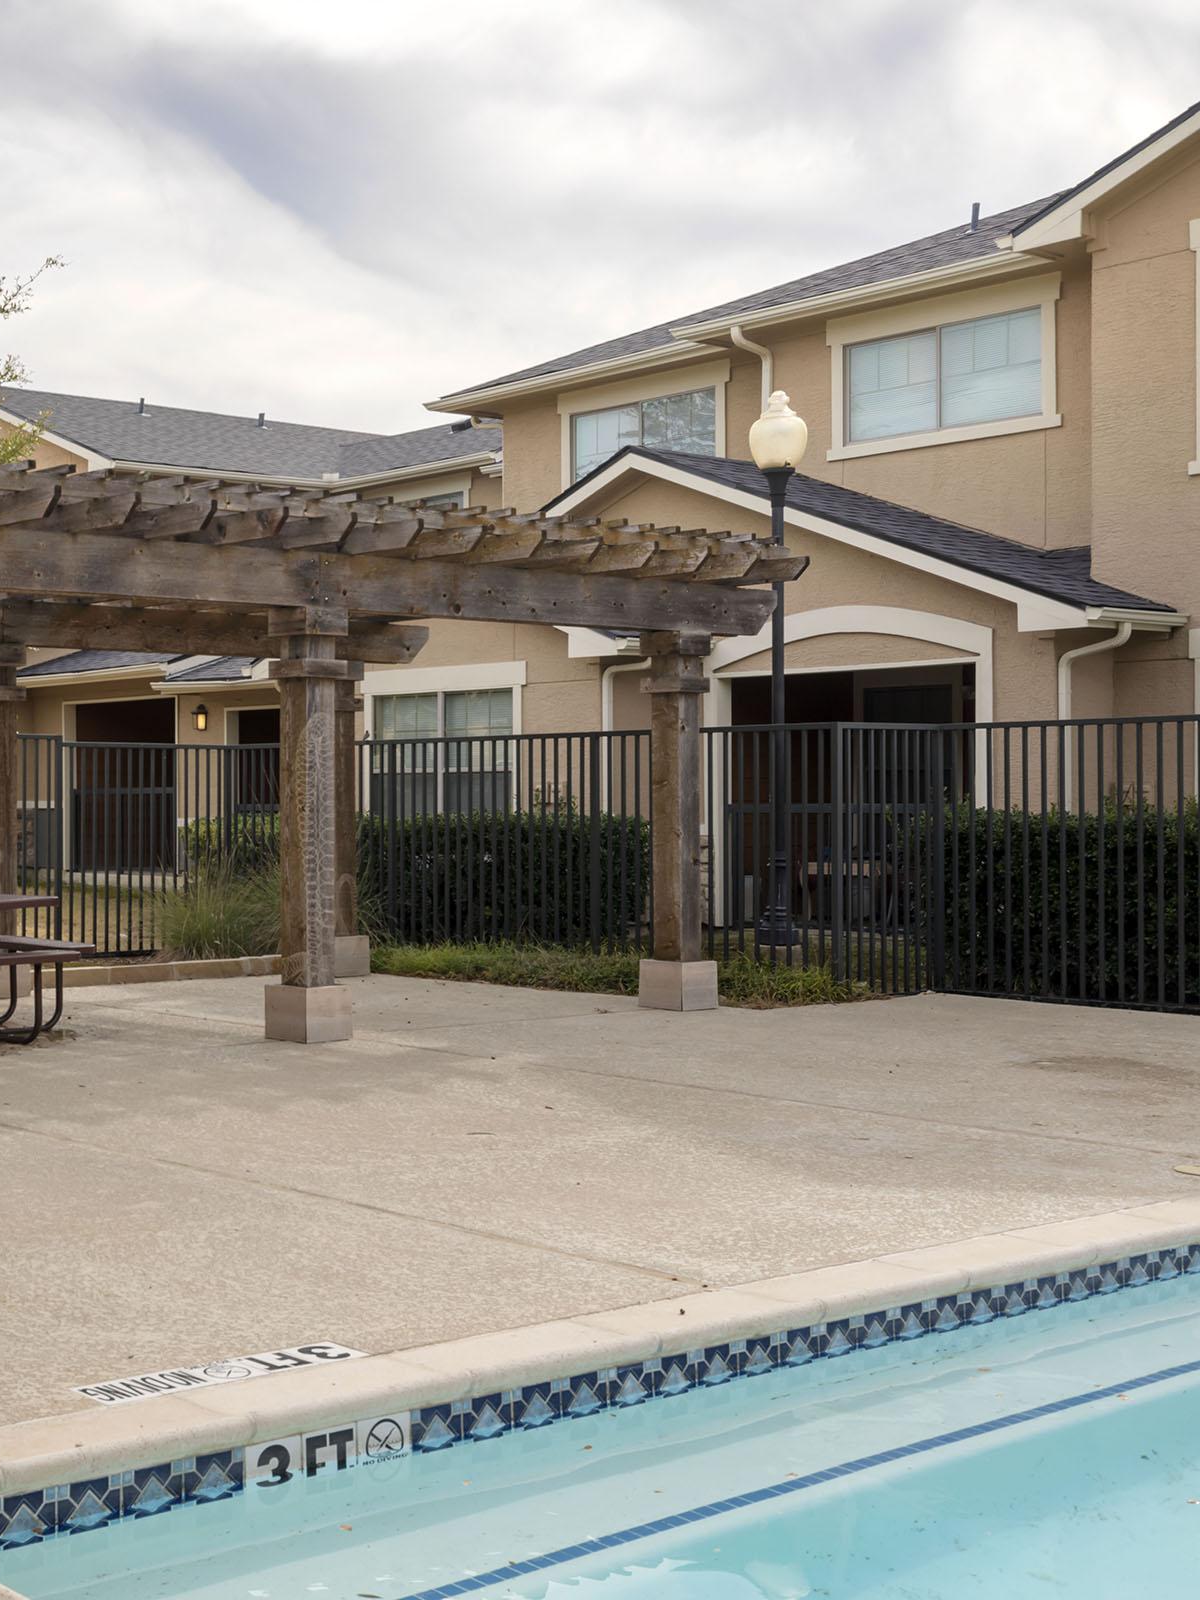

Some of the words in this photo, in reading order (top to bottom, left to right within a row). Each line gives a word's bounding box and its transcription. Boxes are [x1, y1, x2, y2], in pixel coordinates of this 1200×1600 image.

[297, 1345, 351, 1360] 3
[158, 1370, 208, 1386] NO
[78, 1376, 176, 1402] DIVING
[256, 1444, 294, 1488] 3
